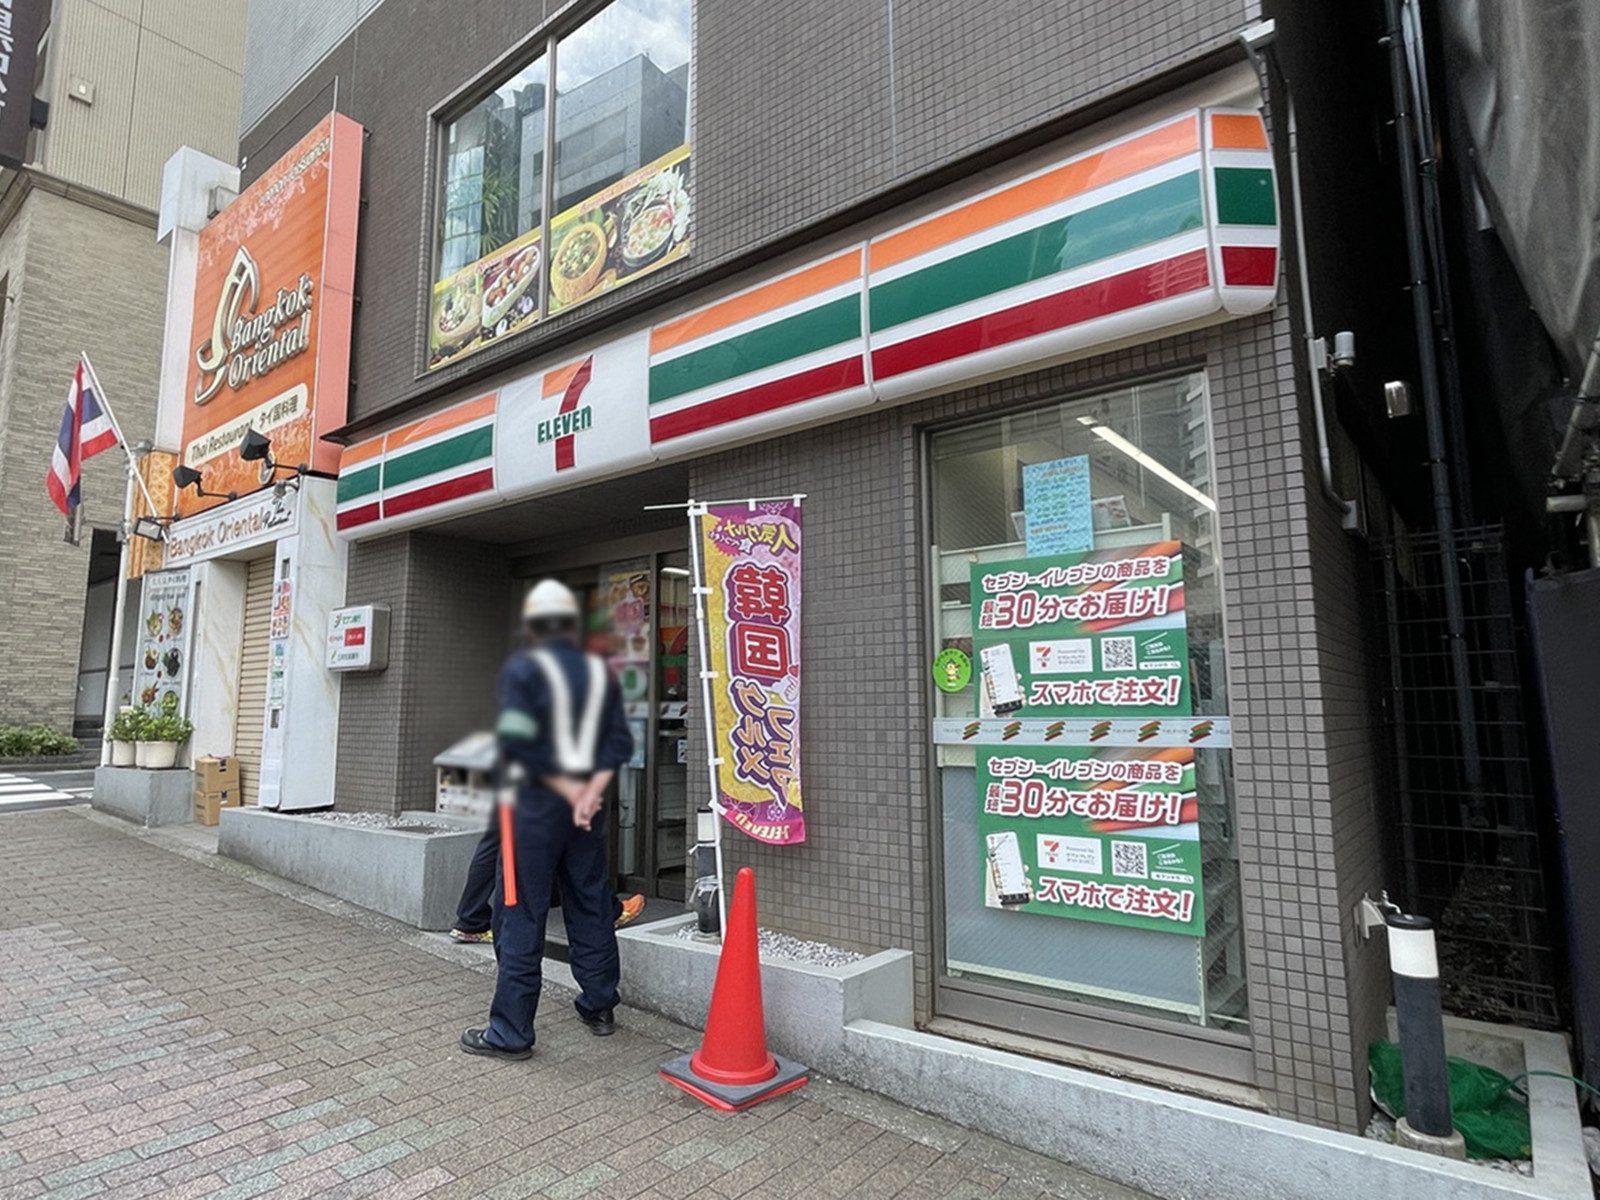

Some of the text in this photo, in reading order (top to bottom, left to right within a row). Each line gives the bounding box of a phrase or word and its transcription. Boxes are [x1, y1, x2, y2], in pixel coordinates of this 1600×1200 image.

[230, 273, 313, 353] Bangkok
[228, 311, 311, 387] Oriental
[542, 354, 593, 471] 7
[191, 438, 208, 462] Thai
[170, 527, 215, 558] Bangkok
[217, 507, 264, 543] Oriental
[1031, 678, 1178, 703] スマホで注文!
[1038, 878, 1192, 919] スマホで注文!
